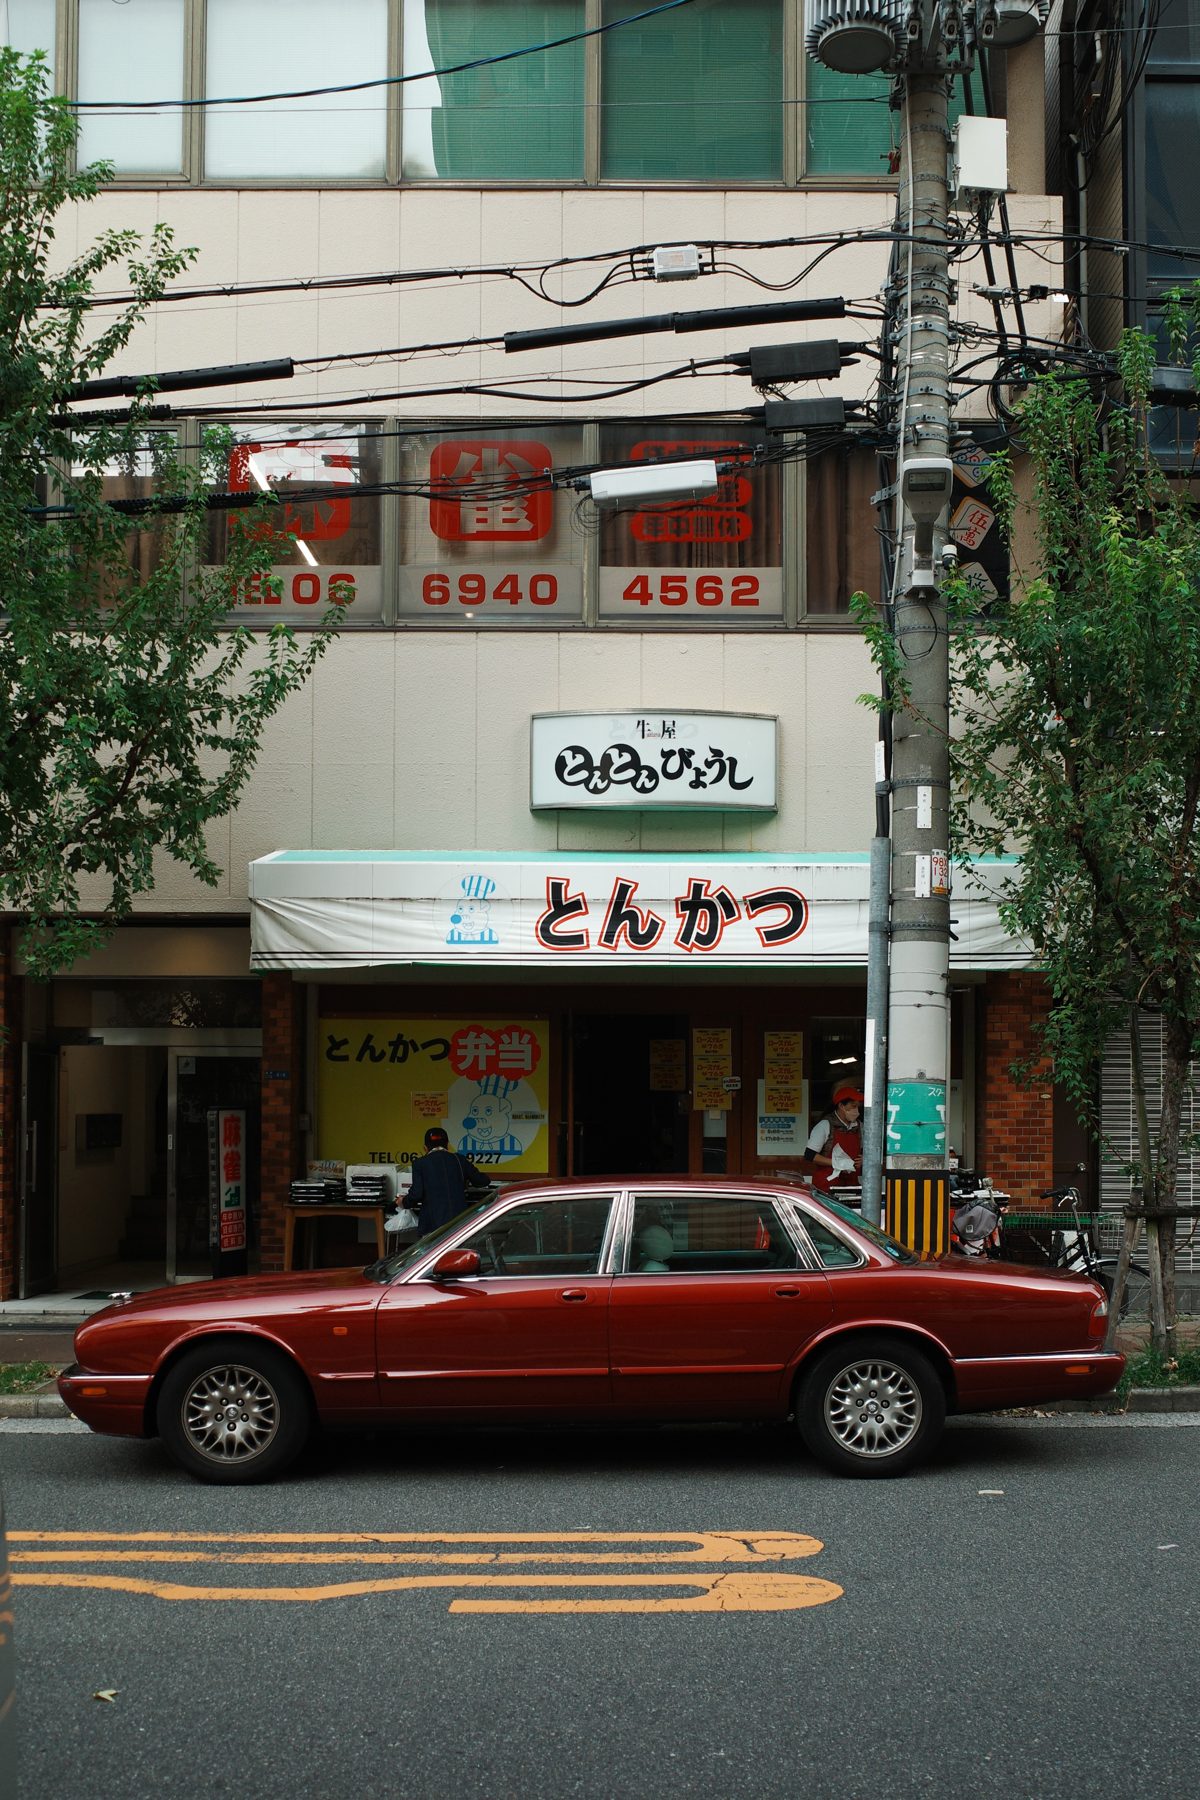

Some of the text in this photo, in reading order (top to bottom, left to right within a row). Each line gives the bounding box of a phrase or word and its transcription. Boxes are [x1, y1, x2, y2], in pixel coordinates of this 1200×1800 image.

[422, 573, 558, 606] 6940
[622, 574, 761, 607] 4562
[555, 743, 754, 795] とんとんびょうし
[535, 876, 809, 953] とんかつ
[466, 1152, 502, 1165] 9227
